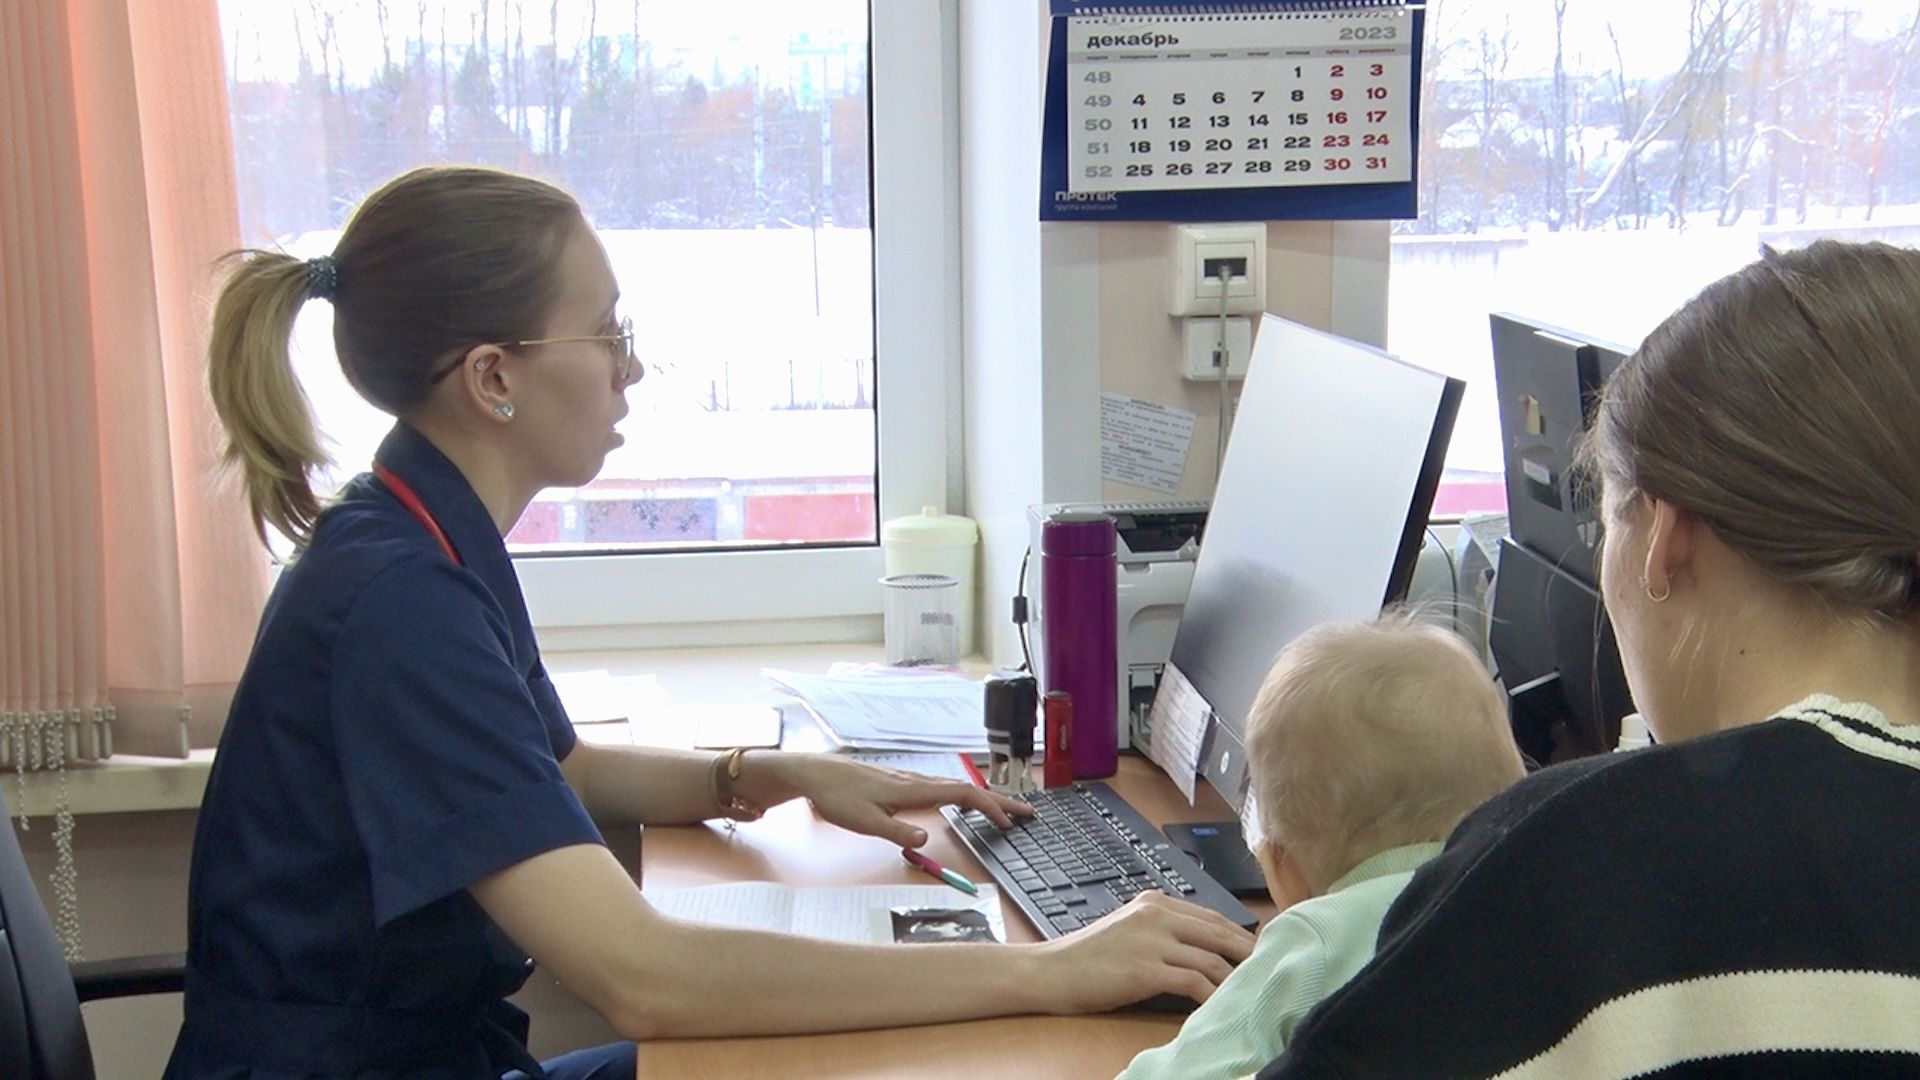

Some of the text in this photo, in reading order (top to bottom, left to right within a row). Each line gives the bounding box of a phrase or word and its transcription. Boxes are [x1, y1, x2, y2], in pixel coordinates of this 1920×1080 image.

[1086, 26, 1396, 50] декабрь 2023
[1083, 63, 1384, 84] 48 1 2 3
[1084, 86, 1388, 108] 49 4 5 6 7 8 9 10
[1084, 109, 1388, 132] 50 11 12 13 14 15 16 17
[1087, 133, 1390, 155] 51 18 19 20 21 22 23 24
[1085, 156, 1387, 178] 52 25 26 27 28 29 30 31
[1055, 191, 1118, 201] ПРОТЕК
